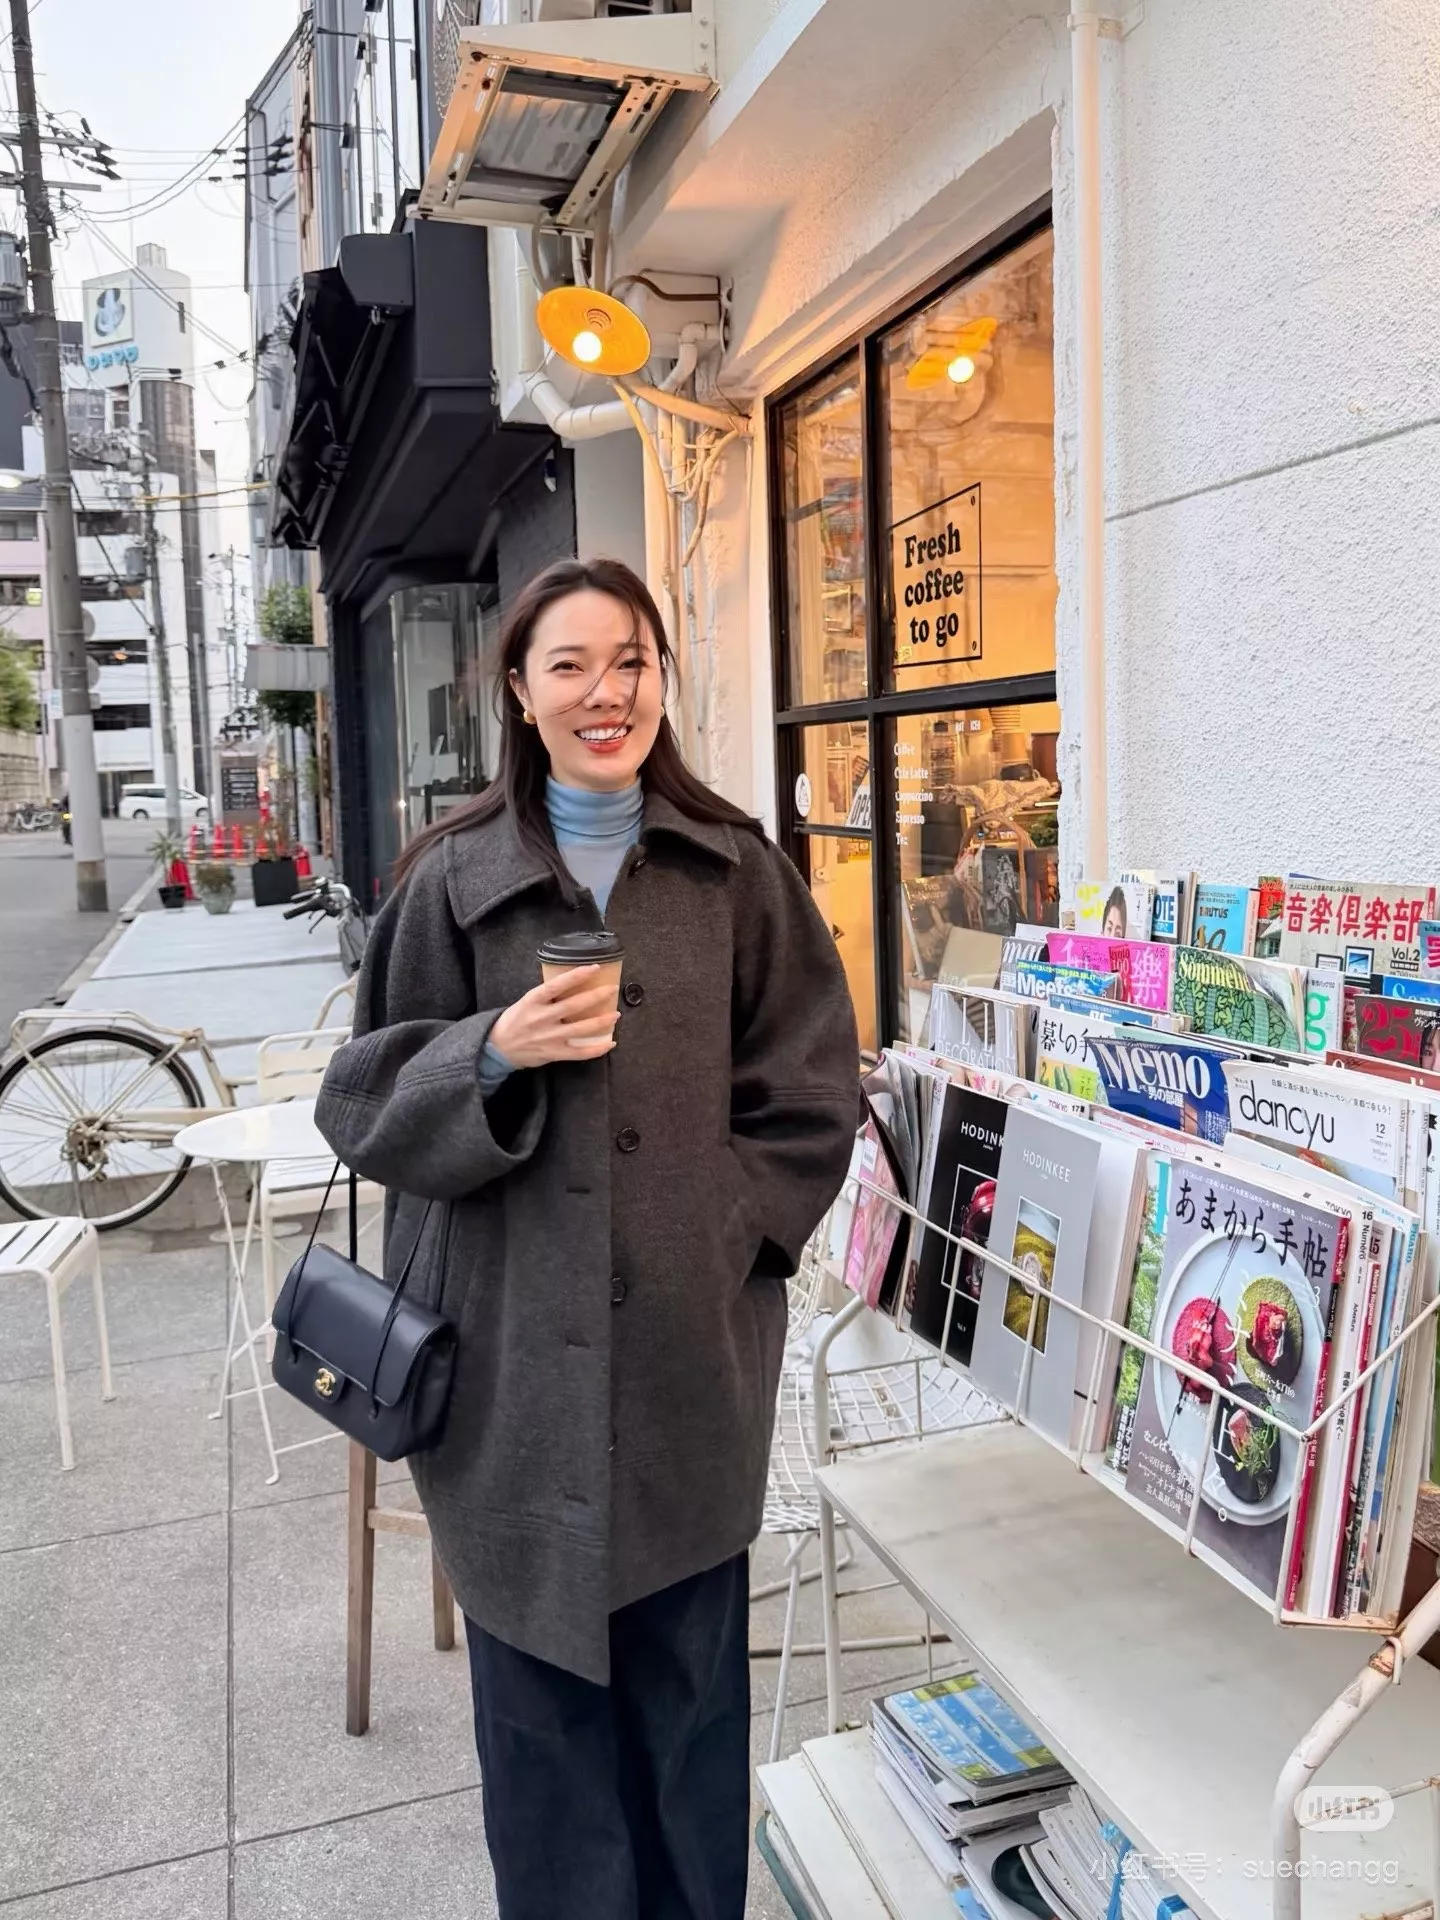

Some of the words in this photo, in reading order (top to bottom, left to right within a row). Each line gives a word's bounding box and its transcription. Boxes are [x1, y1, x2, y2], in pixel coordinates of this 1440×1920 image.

[904, 522, 961, 568] Fresh
[904, 568, 964, 607] coffee
[910, 617, 930, 644] to
[936, 612, 959, 647] go
[1094, 1042, 1211, 1099] Memo
[1239, 1079, 1335, 1150] dancyu
[1375, 1122, 1386, 1134] 12
[1023, 1149, 1072, 1183] HODINKEE
[1361, 1211, 1373, 1221] 16
